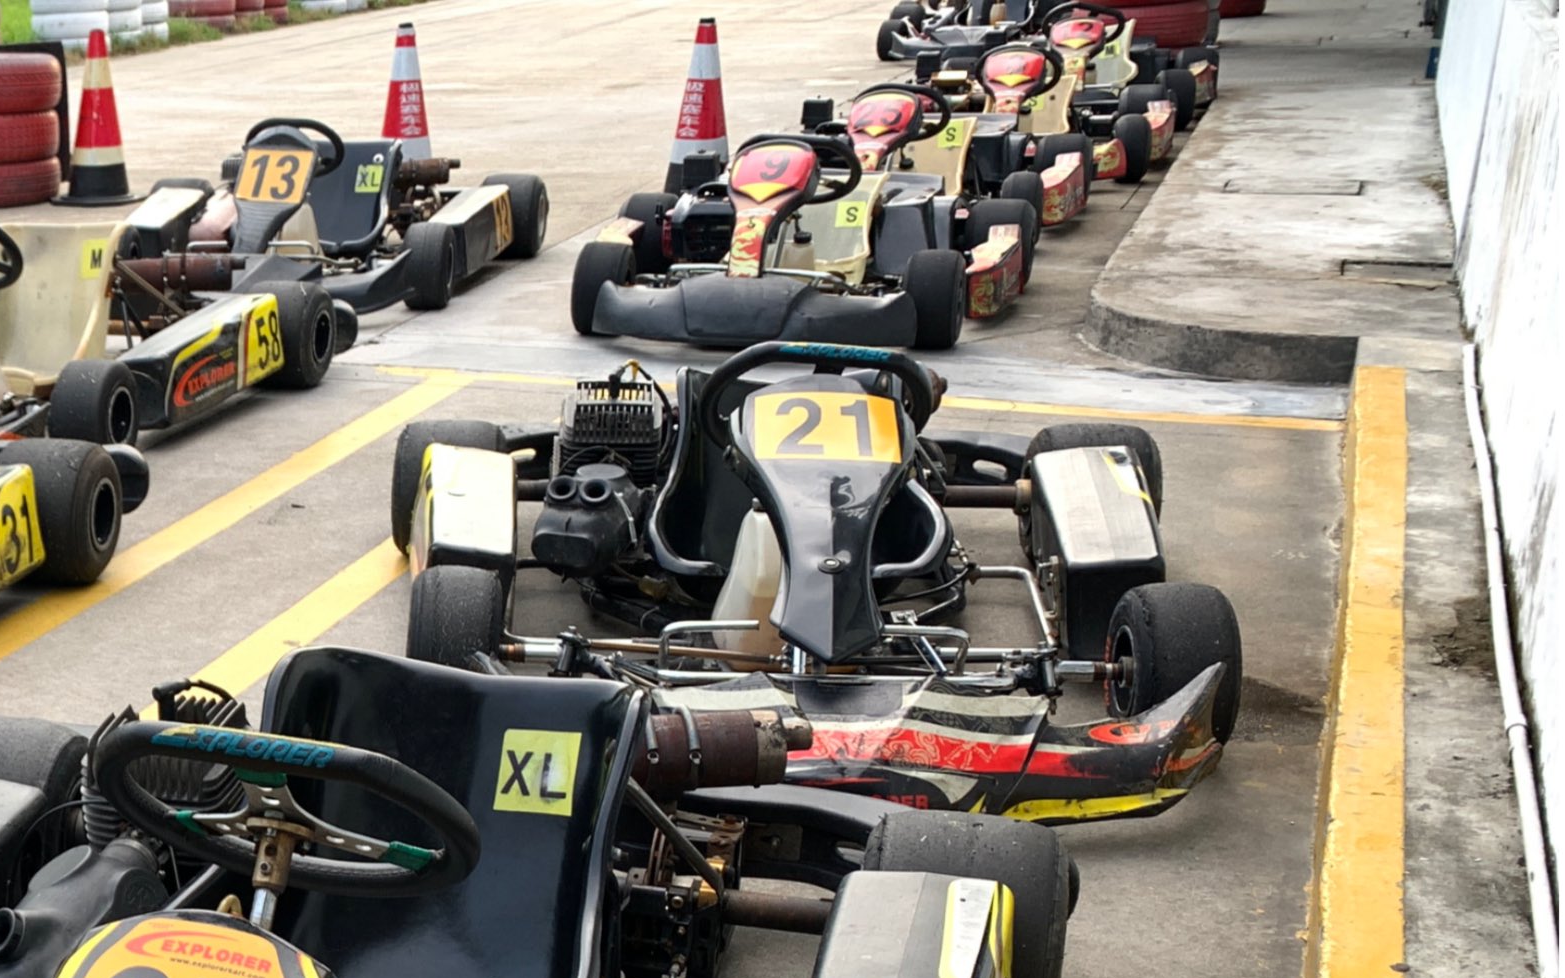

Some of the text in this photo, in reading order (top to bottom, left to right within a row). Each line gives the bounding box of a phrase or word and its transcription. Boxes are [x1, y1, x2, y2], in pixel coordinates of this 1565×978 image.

[945, 128, 957, 142] S
[251, 154, 300, 200] 13
[356, 168, 381, 188] XL
[760, 149, 790, 181] 9
[845, 207, 859, 223] S
[90, 249, 103, 269] M
[255, 310, 281, 371] 58
[776, 397, 873, 457] 21
[1, 494, 34, 575] 31
[501, 750, 567, 800] XL
[160, 939, 272, 973] EXPLORER
